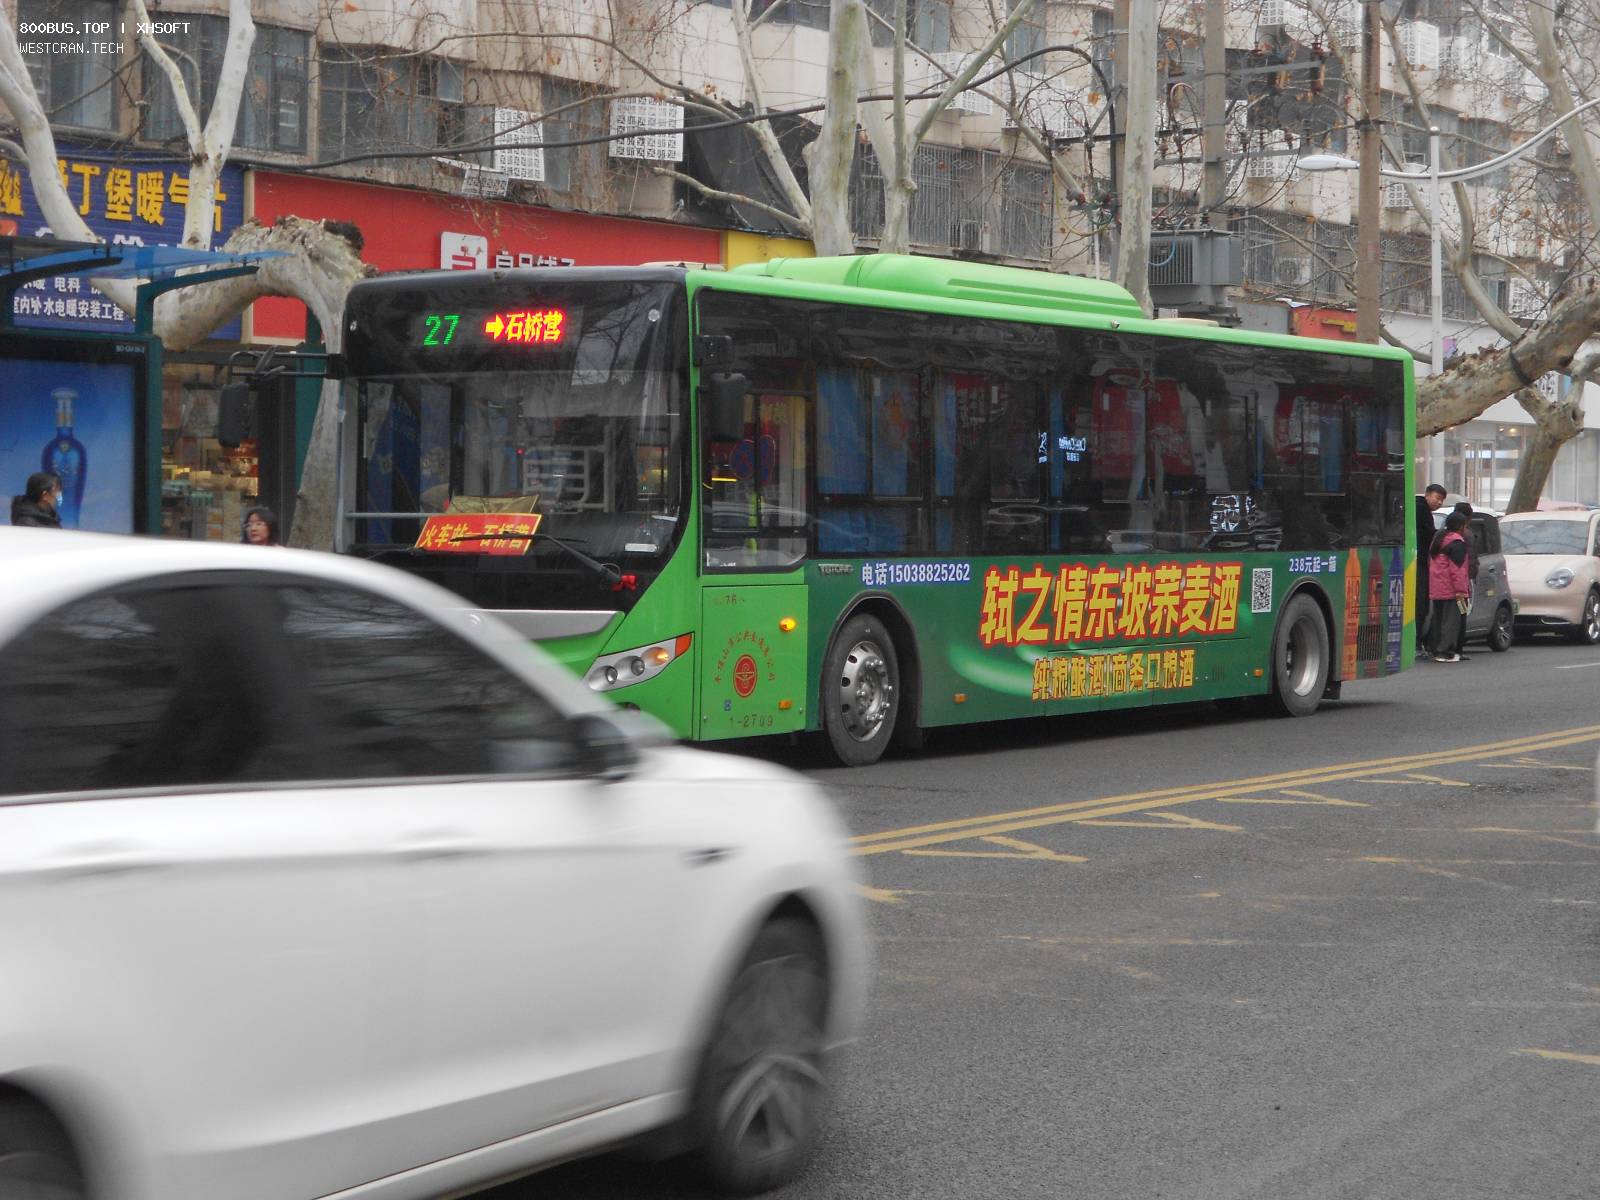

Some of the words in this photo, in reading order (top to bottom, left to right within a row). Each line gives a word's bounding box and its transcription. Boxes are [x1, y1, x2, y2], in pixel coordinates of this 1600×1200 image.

[57, 160, 227, 232] 丁堡暖气
[423, 315, 460, 346] 27
[505, 310, 563, 342] 石桥营
[861, 562, 970, 585] 电话15038825262
[979, 563, 1242, 645] 轼之情东坡荞麦酒
[728, 713, 774, 729] 1-2709
